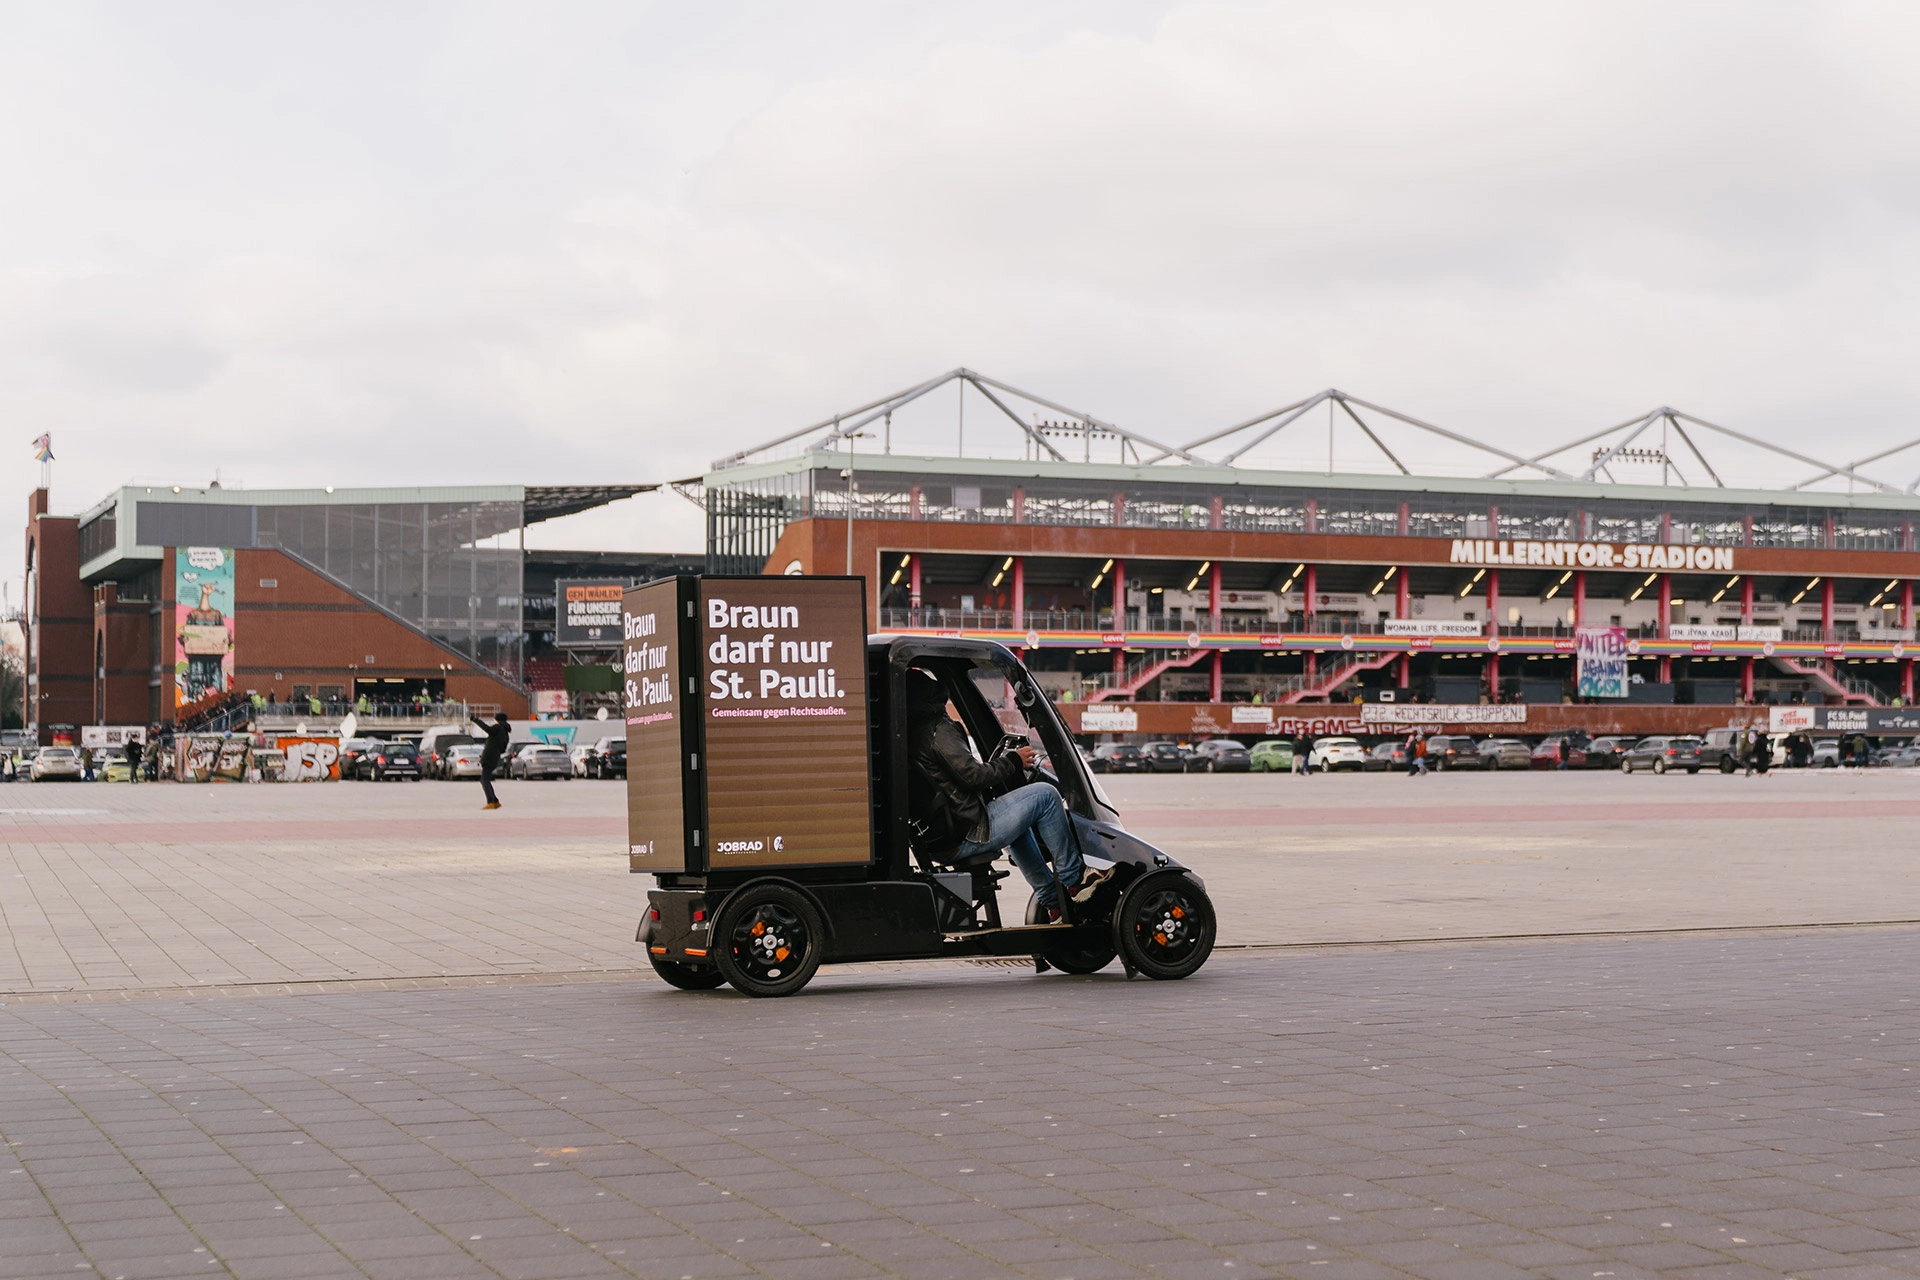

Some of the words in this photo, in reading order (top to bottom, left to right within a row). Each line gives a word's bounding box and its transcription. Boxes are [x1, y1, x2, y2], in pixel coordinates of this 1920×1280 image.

[1450, 539, 1733, 570] MILLERNTOR-STADION
[567, 600, 585, 614] FÜR
[586, 601, 622, 614] UNSERE
[567, 614, 622, 627] DEMOKRATIE.
[708, 598, 799, 629] Braun
[624, 611, 656, 640] Braun
[625, 641, 648, 674] darf
[648, 644, 668, 670] nur
[708, 633, 775, 664] darf
[780, 641, 833, 663] nur
[626, 679, 641, 708] St.
[642, 672, 673, 706] Pauli.
[710, 669, 752, 700] St.
[760, 668, 845, 699] Pauli.
[712, 708, 763, 717] Gemeinsam
[763, 709, 790, 719] gegen
[790, 706, 847, 716] Rechtsaußen.
[1827, 720, 1867, 730] MUSEUM
[717, 840, 764, 852] JOBRAD
